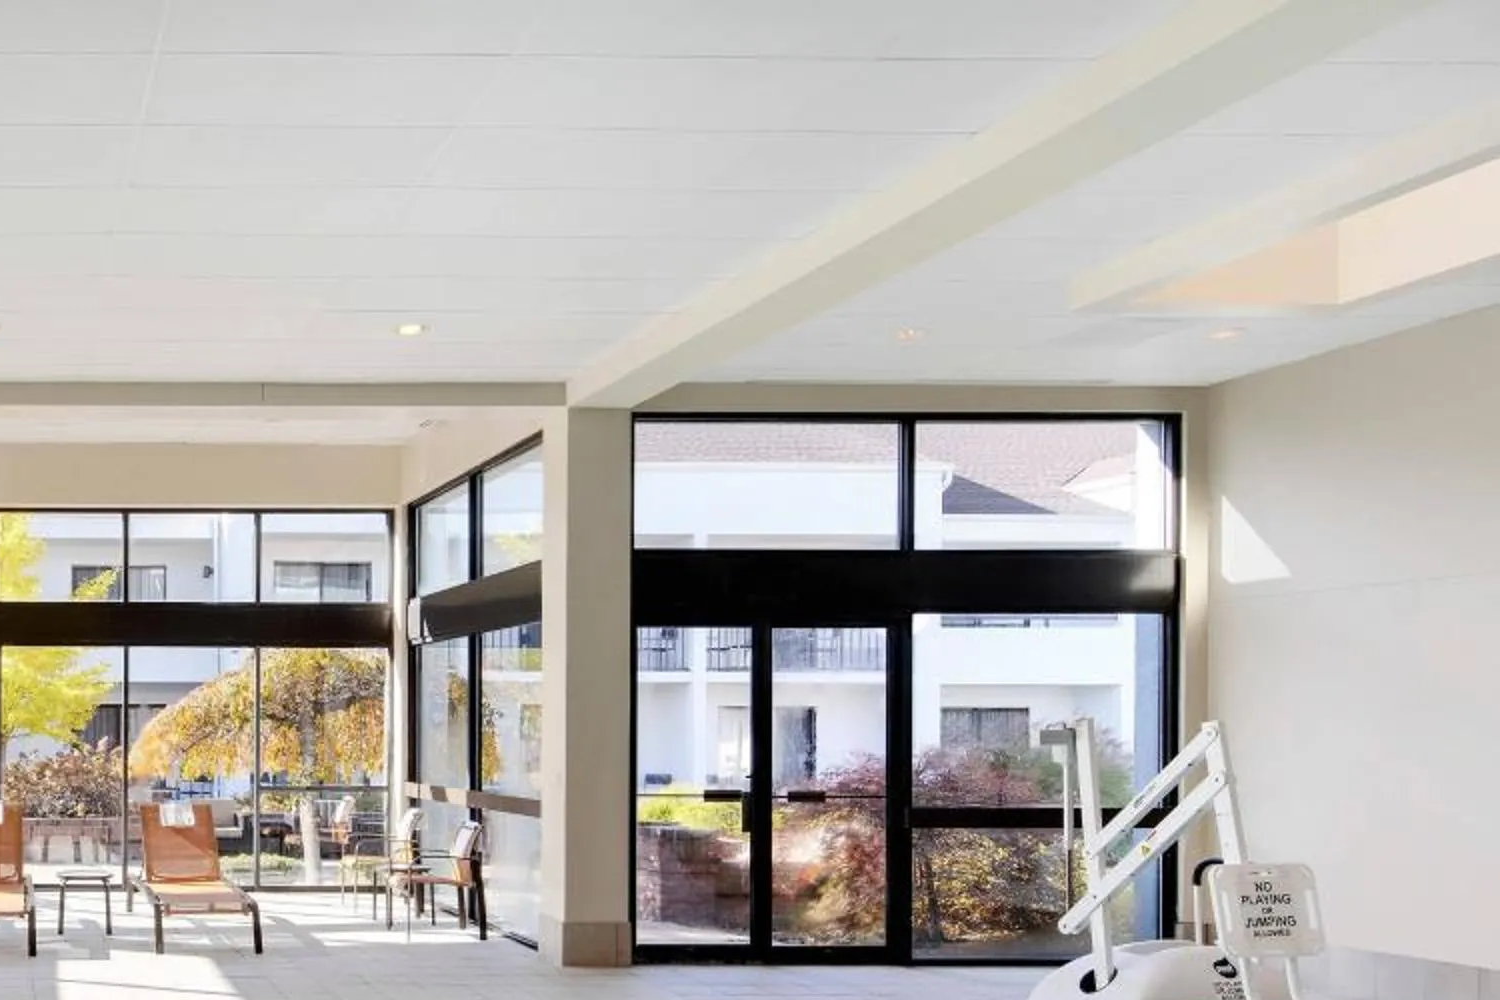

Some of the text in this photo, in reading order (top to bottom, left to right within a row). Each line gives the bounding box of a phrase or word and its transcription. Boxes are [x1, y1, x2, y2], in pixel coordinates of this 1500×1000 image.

[1254, 881, 1272, 893] NO
[1240, 893, 1291, 905] PLAYING
[1245, 915, 1297, 928] JUMPING
